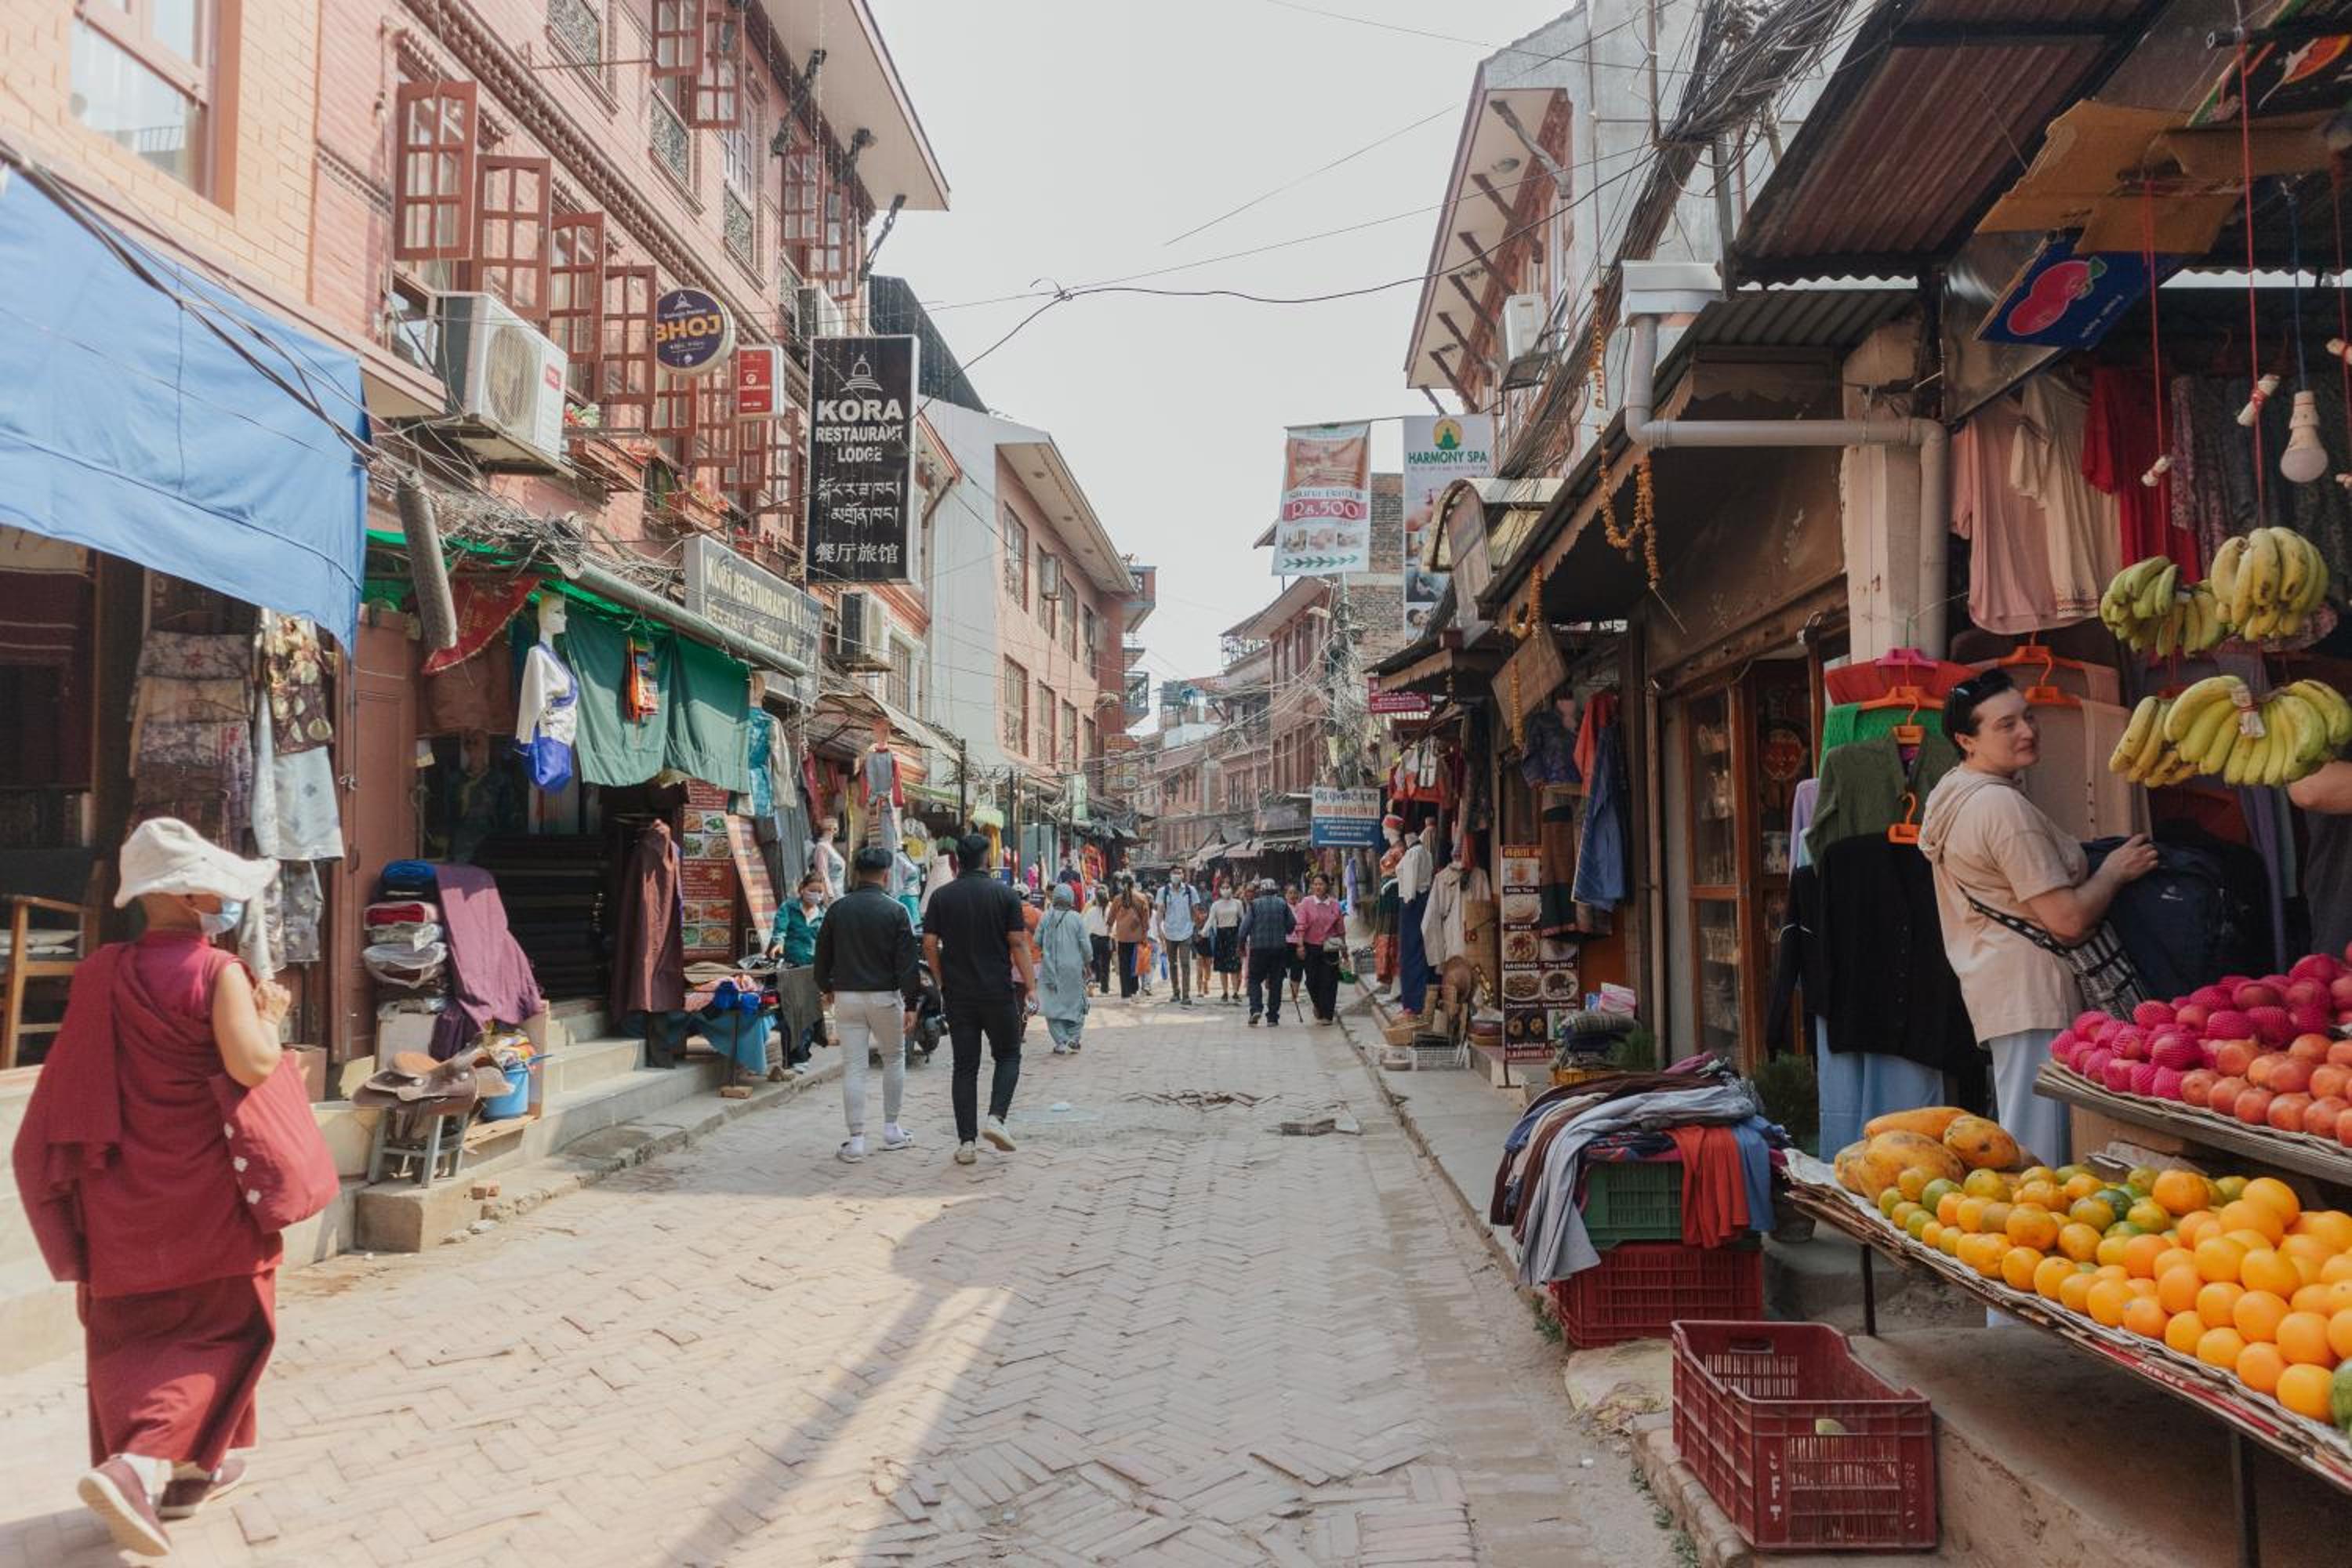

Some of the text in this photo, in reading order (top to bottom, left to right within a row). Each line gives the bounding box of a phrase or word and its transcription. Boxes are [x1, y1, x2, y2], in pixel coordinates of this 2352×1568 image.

[816, 398, 904, 422] KORA
[815, 425, 903, 442] RESTAURANT
[837, 446, 882, 463] LODGE
[1408, 451, 1487, 464] HARMONY SPA
[815, 543, 899, 564] 餐厅旅馆
